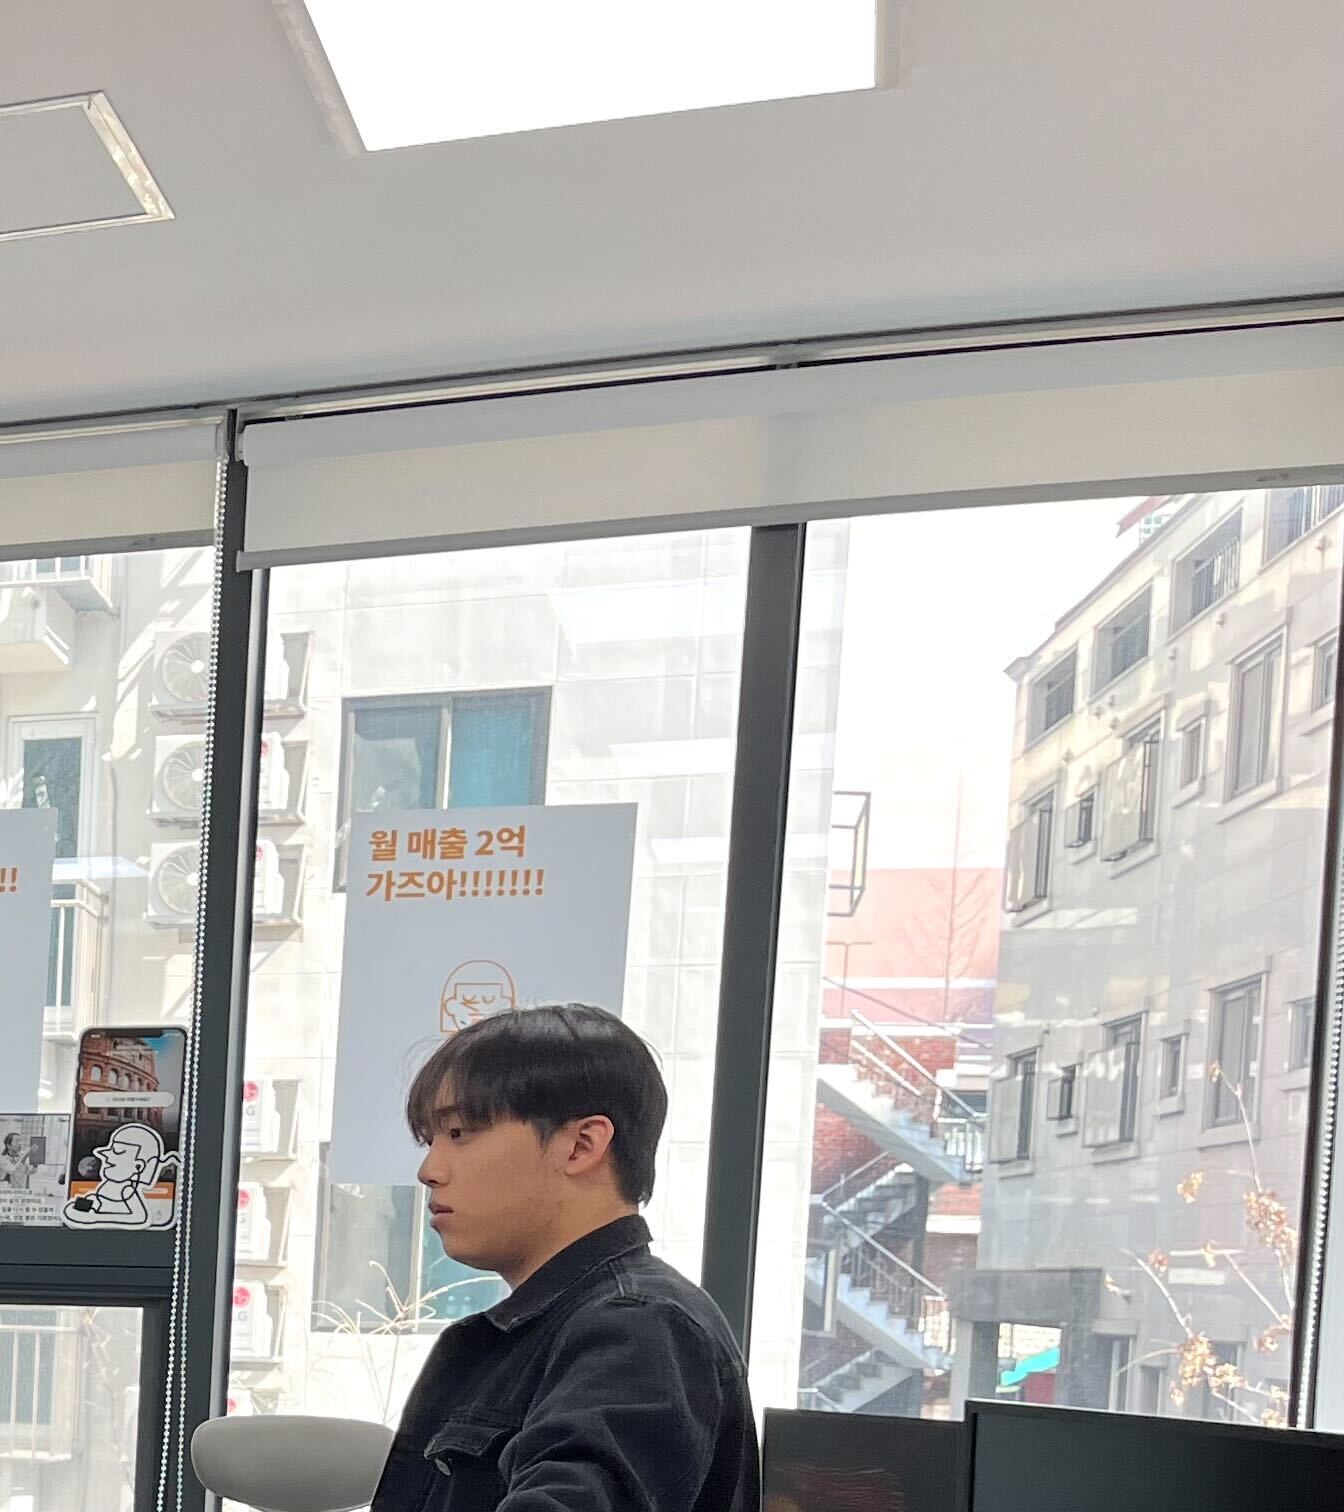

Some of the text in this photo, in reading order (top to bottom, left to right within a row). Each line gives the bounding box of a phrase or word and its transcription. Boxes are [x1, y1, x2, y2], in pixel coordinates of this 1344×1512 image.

[369, 825, 526, 861] 월 매출 2억
[366, 869, 544, 902] 가즈아!!!!!!!
